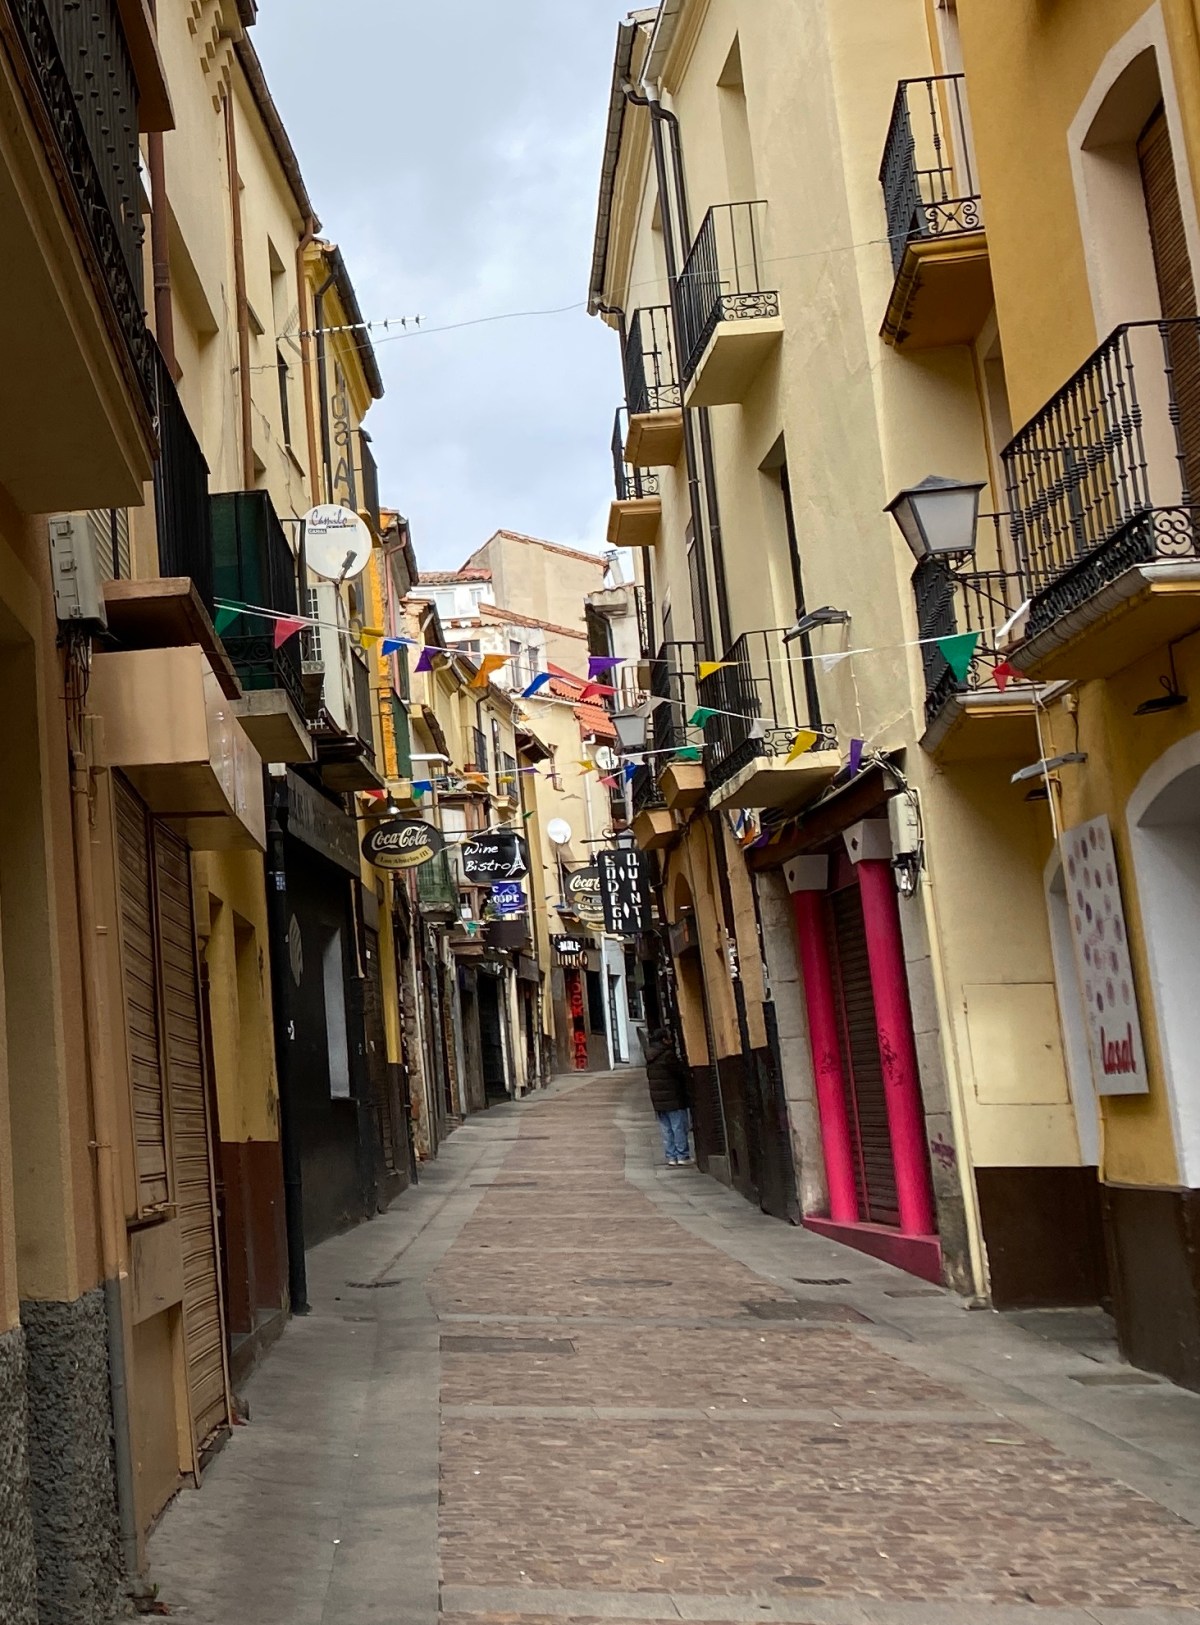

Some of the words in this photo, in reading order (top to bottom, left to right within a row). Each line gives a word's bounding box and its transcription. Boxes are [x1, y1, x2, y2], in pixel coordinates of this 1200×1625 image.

[371, 824, 430, 851] Coca-Cola
[464, 842, 499, 856] Wine
[465, 860, 511, 872] Bistro
[574, 1031, 588, 1069] BAR
